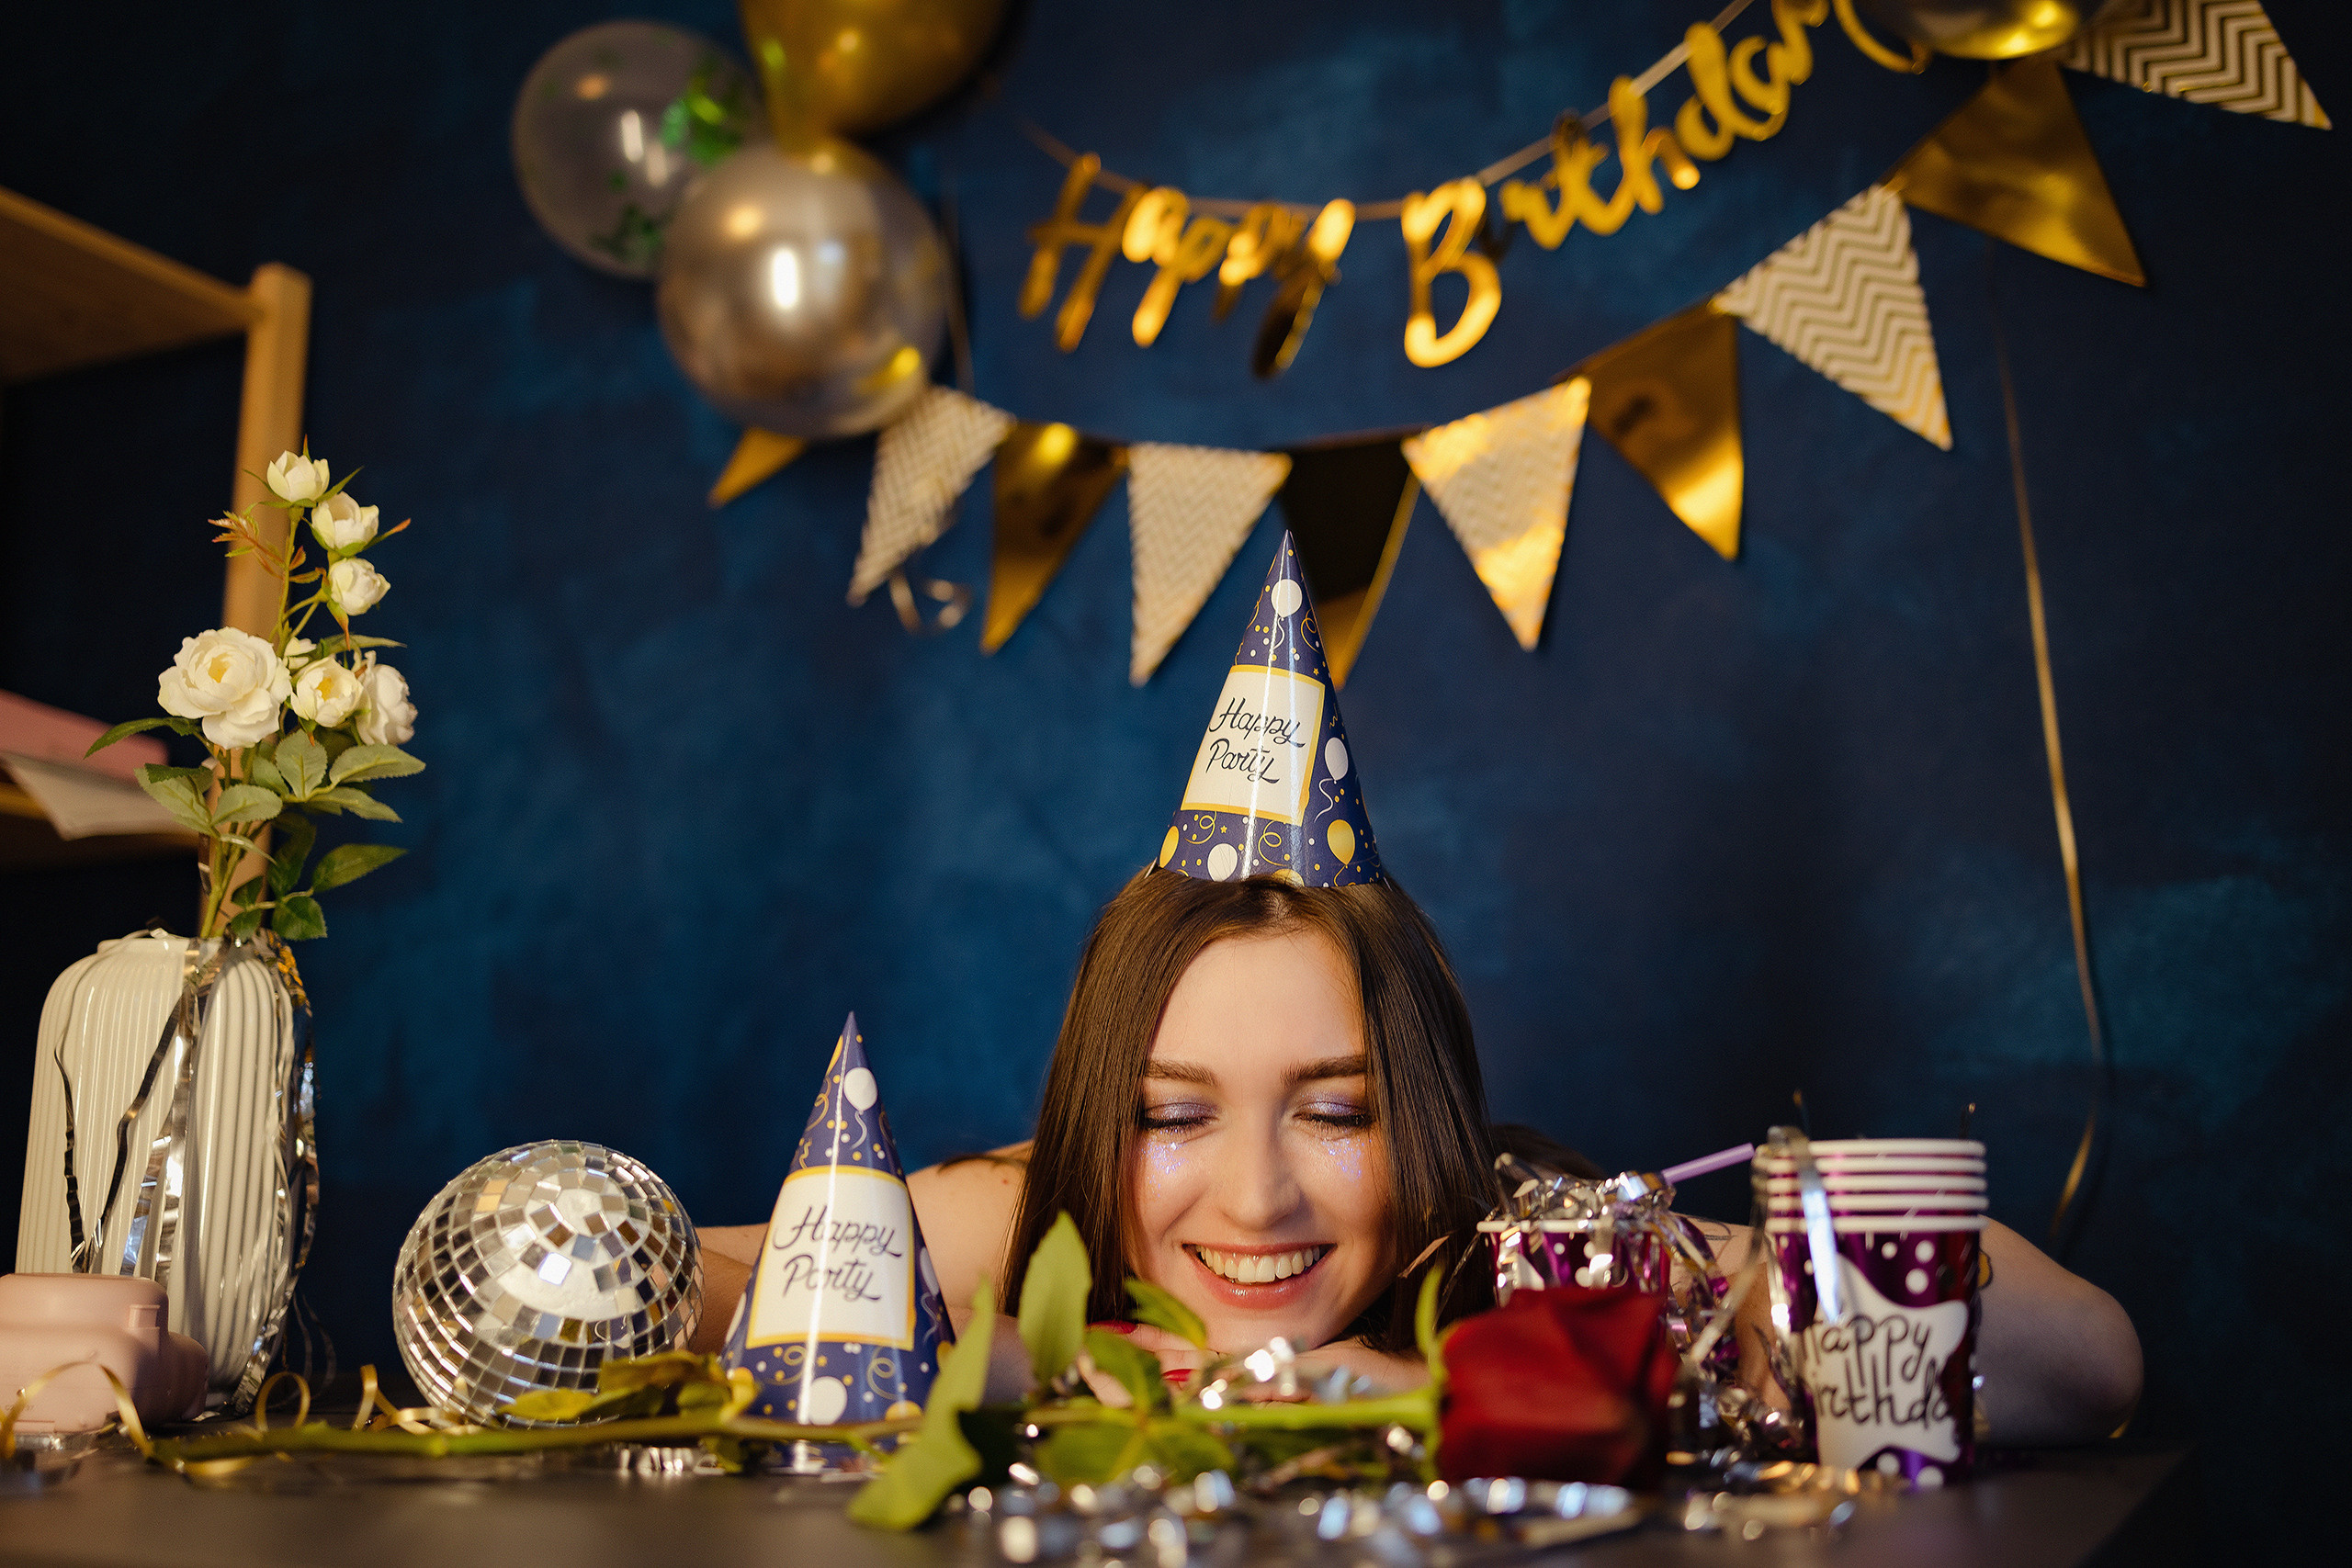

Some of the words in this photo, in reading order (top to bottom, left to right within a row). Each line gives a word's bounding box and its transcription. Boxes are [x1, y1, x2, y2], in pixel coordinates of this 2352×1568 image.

[1208, 697, 1306, 748] Happy
[1205, 738, 1280, 784] Party
[773, 1204, 902, 1258] Happy
